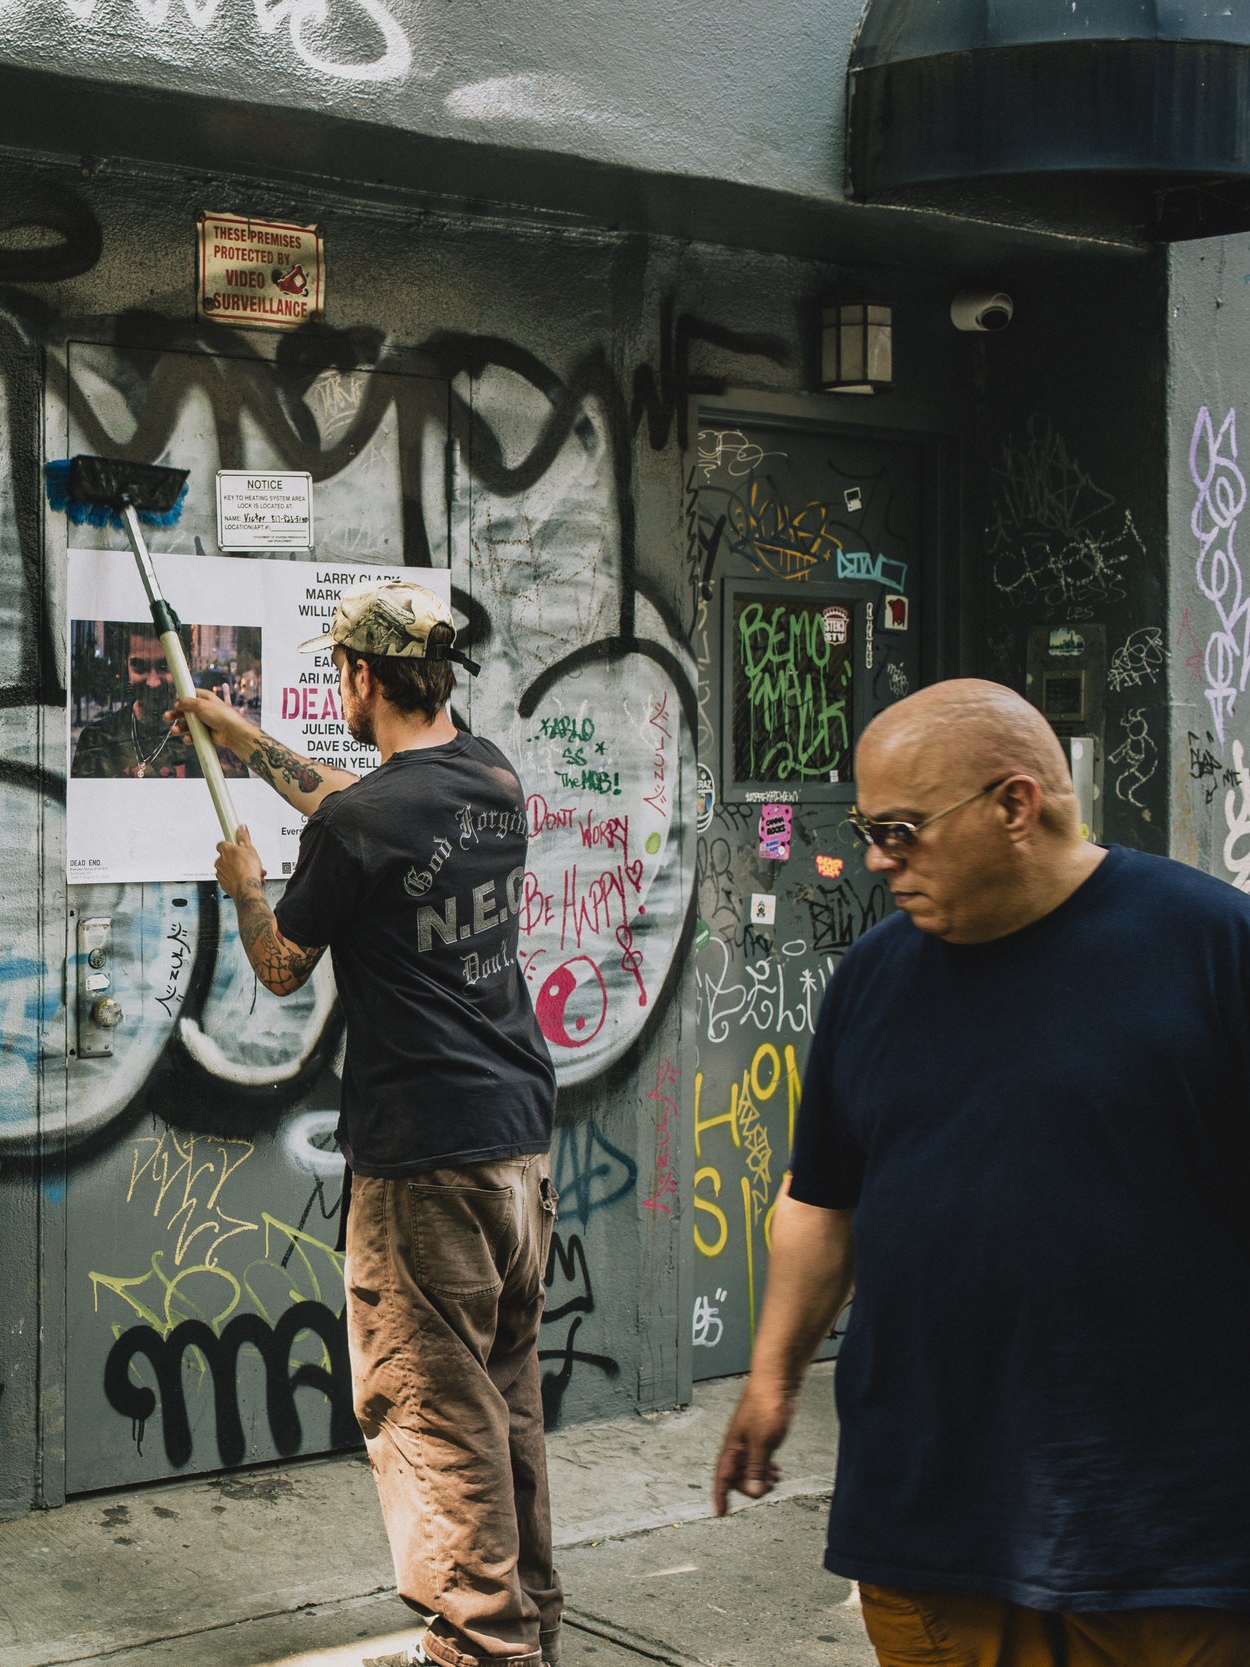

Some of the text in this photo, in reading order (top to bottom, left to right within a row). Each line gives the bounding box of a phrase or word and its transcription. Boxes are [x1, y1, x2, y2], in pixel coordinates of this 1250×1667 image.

[213, 226, 302, 249] THESE PREMISES
[214, 245, 291, 266] PROTECTED BY
[225, 269, 266, 290] VIDEO
[213, 292, 308, 318] SURVEILLANCE
[247, 480, 283, 490] NOTICE
[316, 572, 356, 584] LARRY
[305, 588, 342, 600] MARK
[299, 672, 320, 683] ARI
[281, 687, 346, 720] DEA
[301, 723, 344, 735] JULIEN
[307, 740, 340, 751] DAVE
[519, 871, 555, 936] BE
